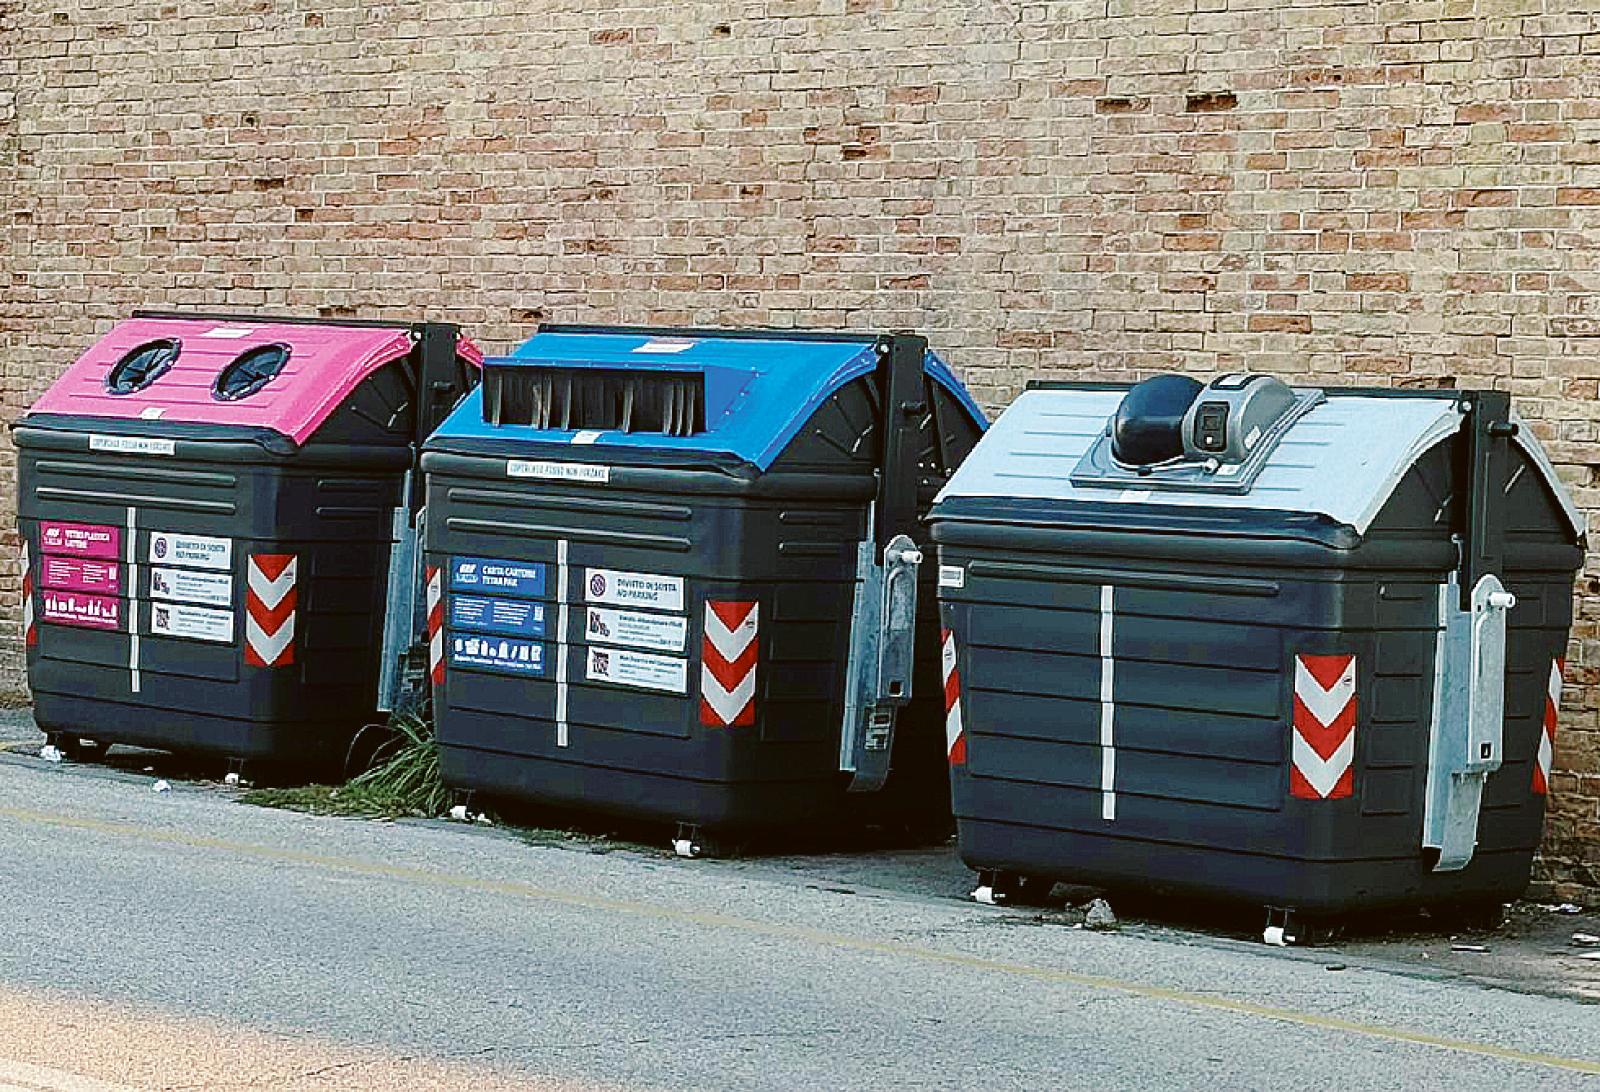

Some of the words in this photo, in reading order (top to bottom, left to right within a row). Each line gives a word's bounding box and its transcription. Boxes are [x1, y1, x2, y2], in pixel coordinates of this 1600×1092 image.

[618, 579, 645, 588] DIVIETO
[646, 580, 654, 589] DI
[655, 581, 677, 592] SOSTA
[617, 589, 627, 598] NO
[628, 590, 658, 601] PARKING
